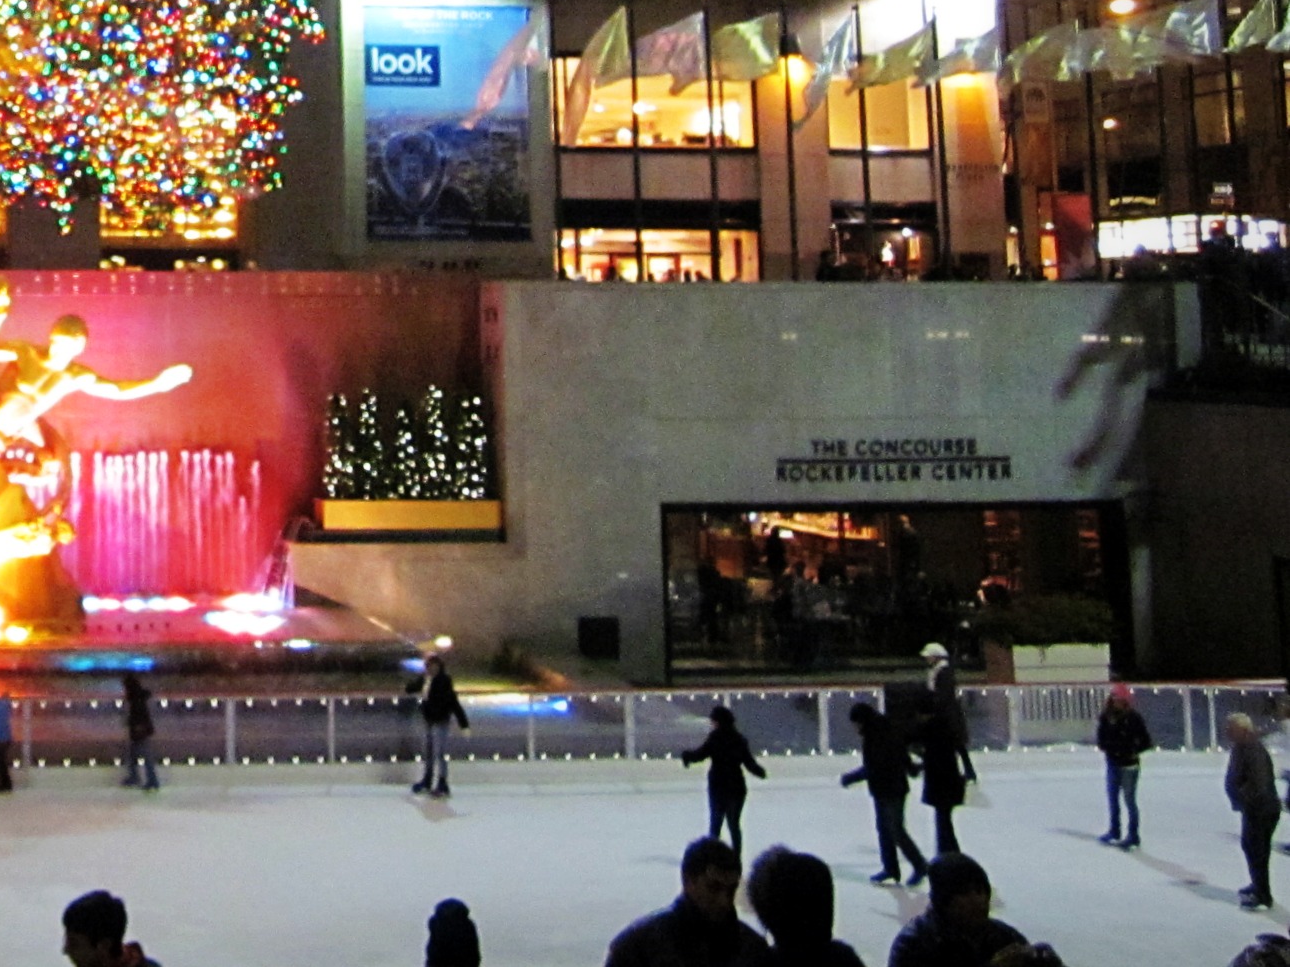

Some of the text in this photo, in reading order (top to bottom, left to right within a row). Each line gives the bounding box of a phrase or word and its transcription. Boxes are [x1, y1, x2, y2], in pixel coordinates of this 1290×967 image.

[461, 10, 494, 21] ROCK
[371, 46, 433, 75] look
[811, 438, 977, 457] THE CONCOURSE
[776, 463, 1011, 482] ROCKEFELLER CENTER
